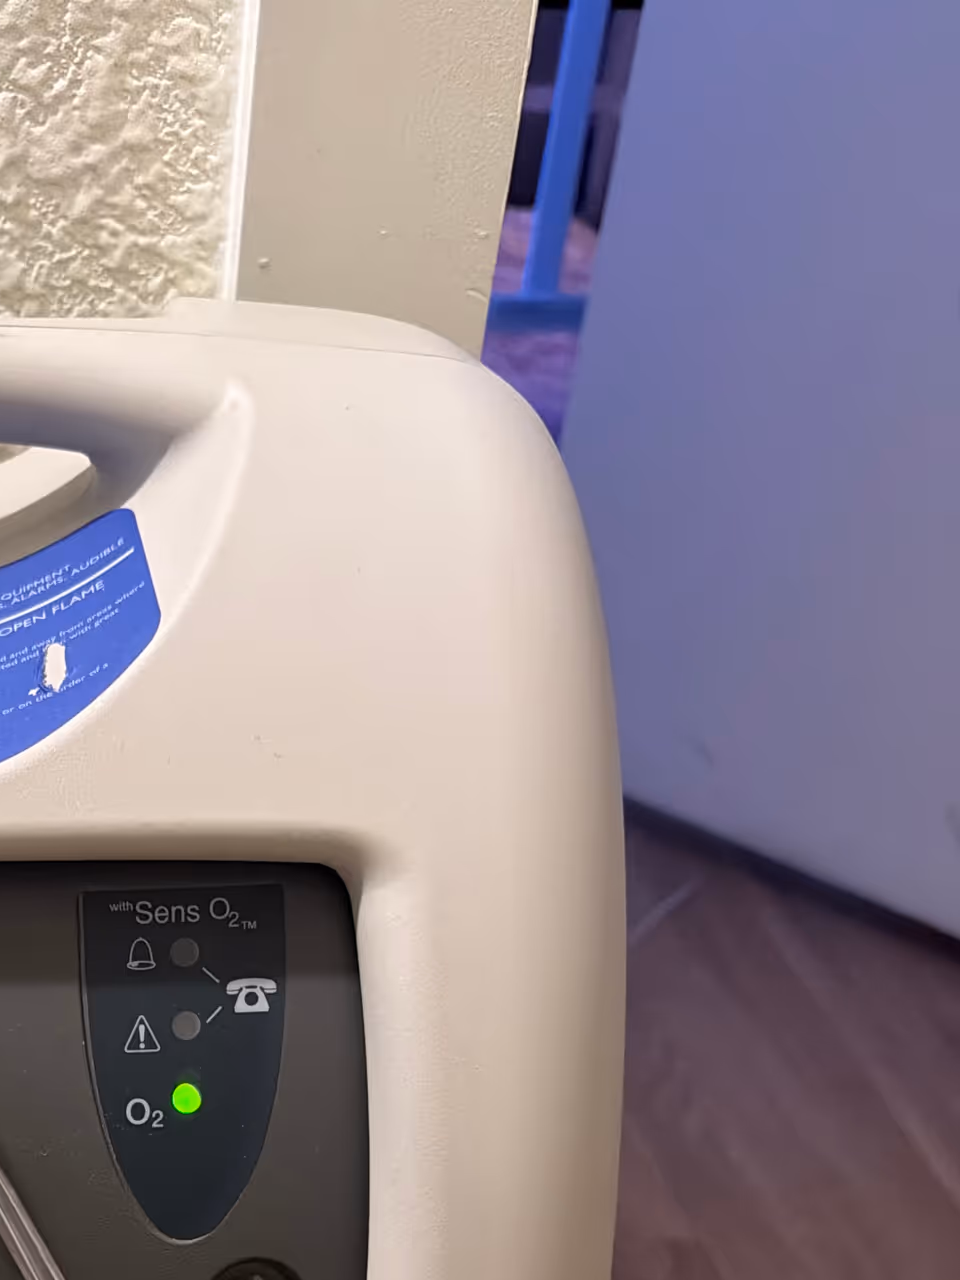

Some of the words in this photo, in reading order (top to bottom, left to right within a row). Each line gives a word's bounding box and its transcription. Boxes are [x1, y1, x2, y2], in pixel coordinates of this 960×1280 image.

[70, 537, 125, 577] AUDIBLE
[9, 648, 28, 660] and
[31, 636, 56, 652] away
[58, 622, 84, 638] from
[86, 604, 113, 625] areas
[114, 581, 146, 605] where
[21, 650, 40, 664] and
[69, 625, 91, 640] with
[93, 607, 120, 628] great
[2, 707, 15, 716] or
[18, 700, 33, 711] on
[35, 690, 53, 704] the
[89, 666, 101, 677] of
[109, 901, 134, 912] with
[135, 901, 200, 925] Sens
